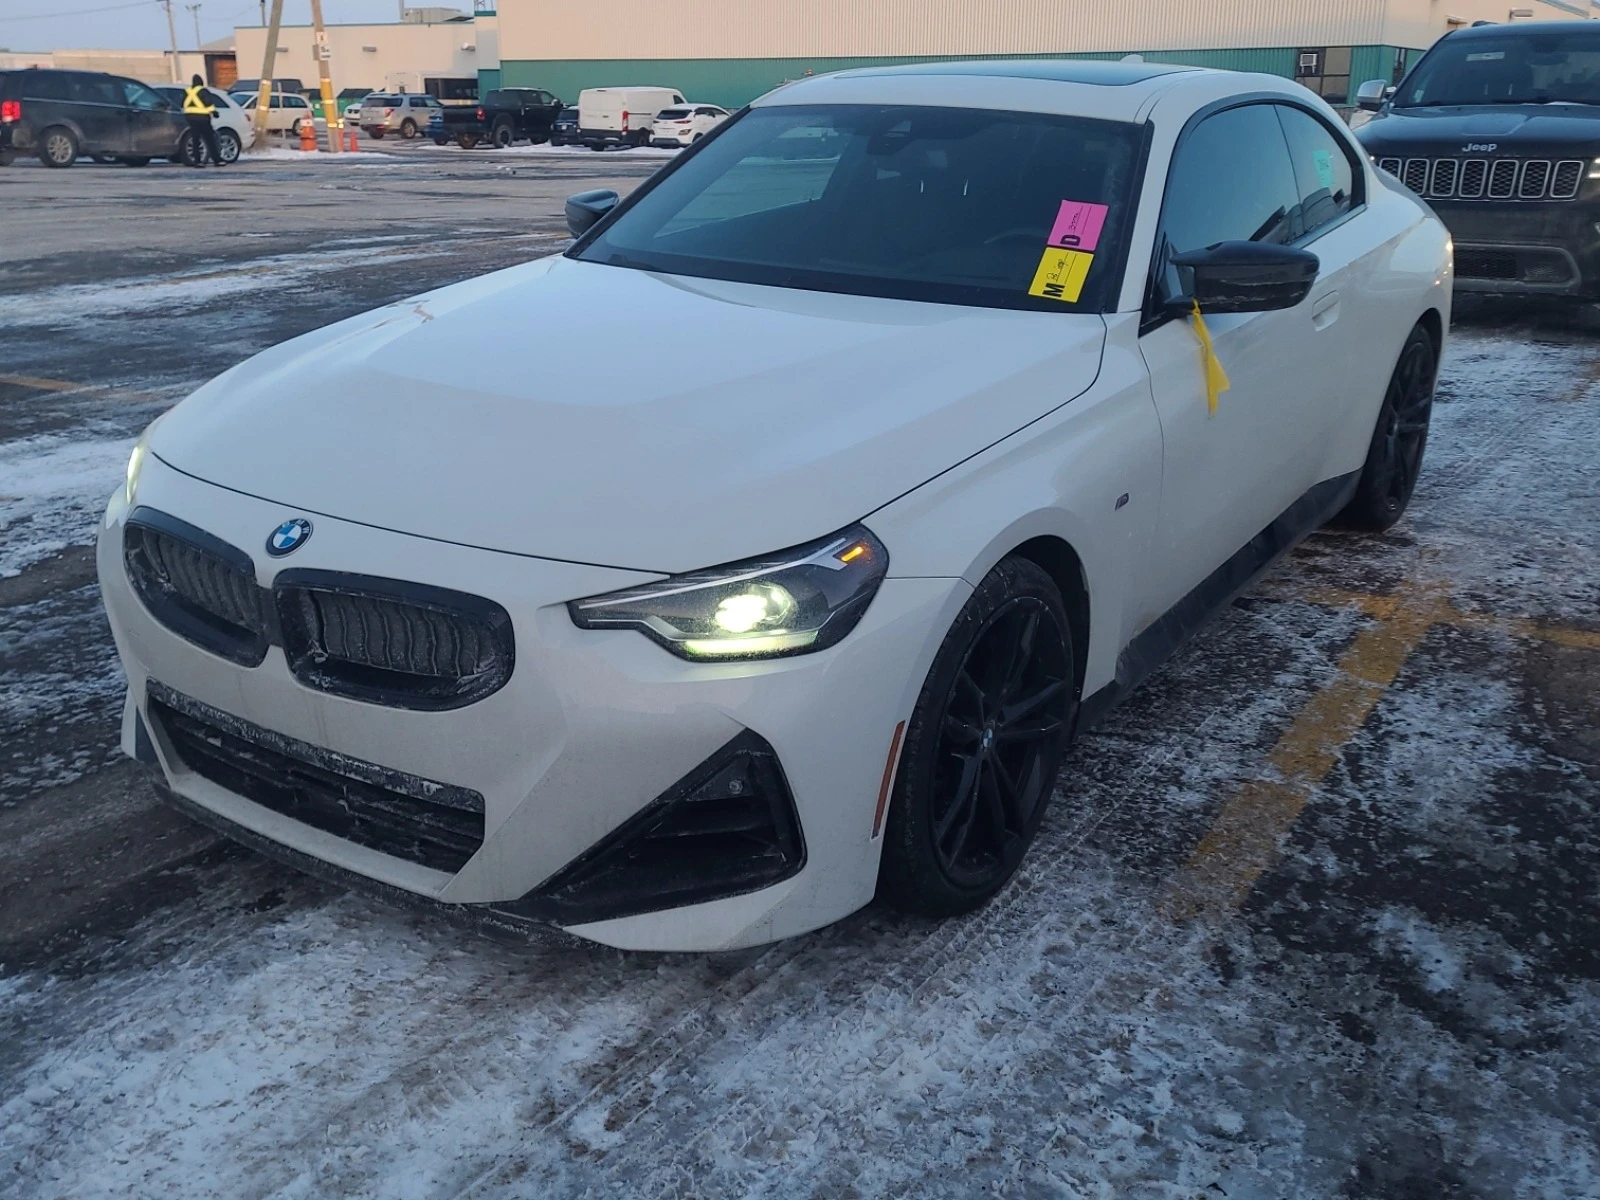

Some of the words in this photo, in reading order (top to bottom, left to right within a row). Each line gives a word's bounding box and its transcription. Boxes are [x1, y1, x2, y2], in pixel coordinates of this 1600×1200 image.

[1462, 143, 1497, 152] Jeep
[1060, 235, 1081, 246] D
[1042, 283, 1065, 297] M
